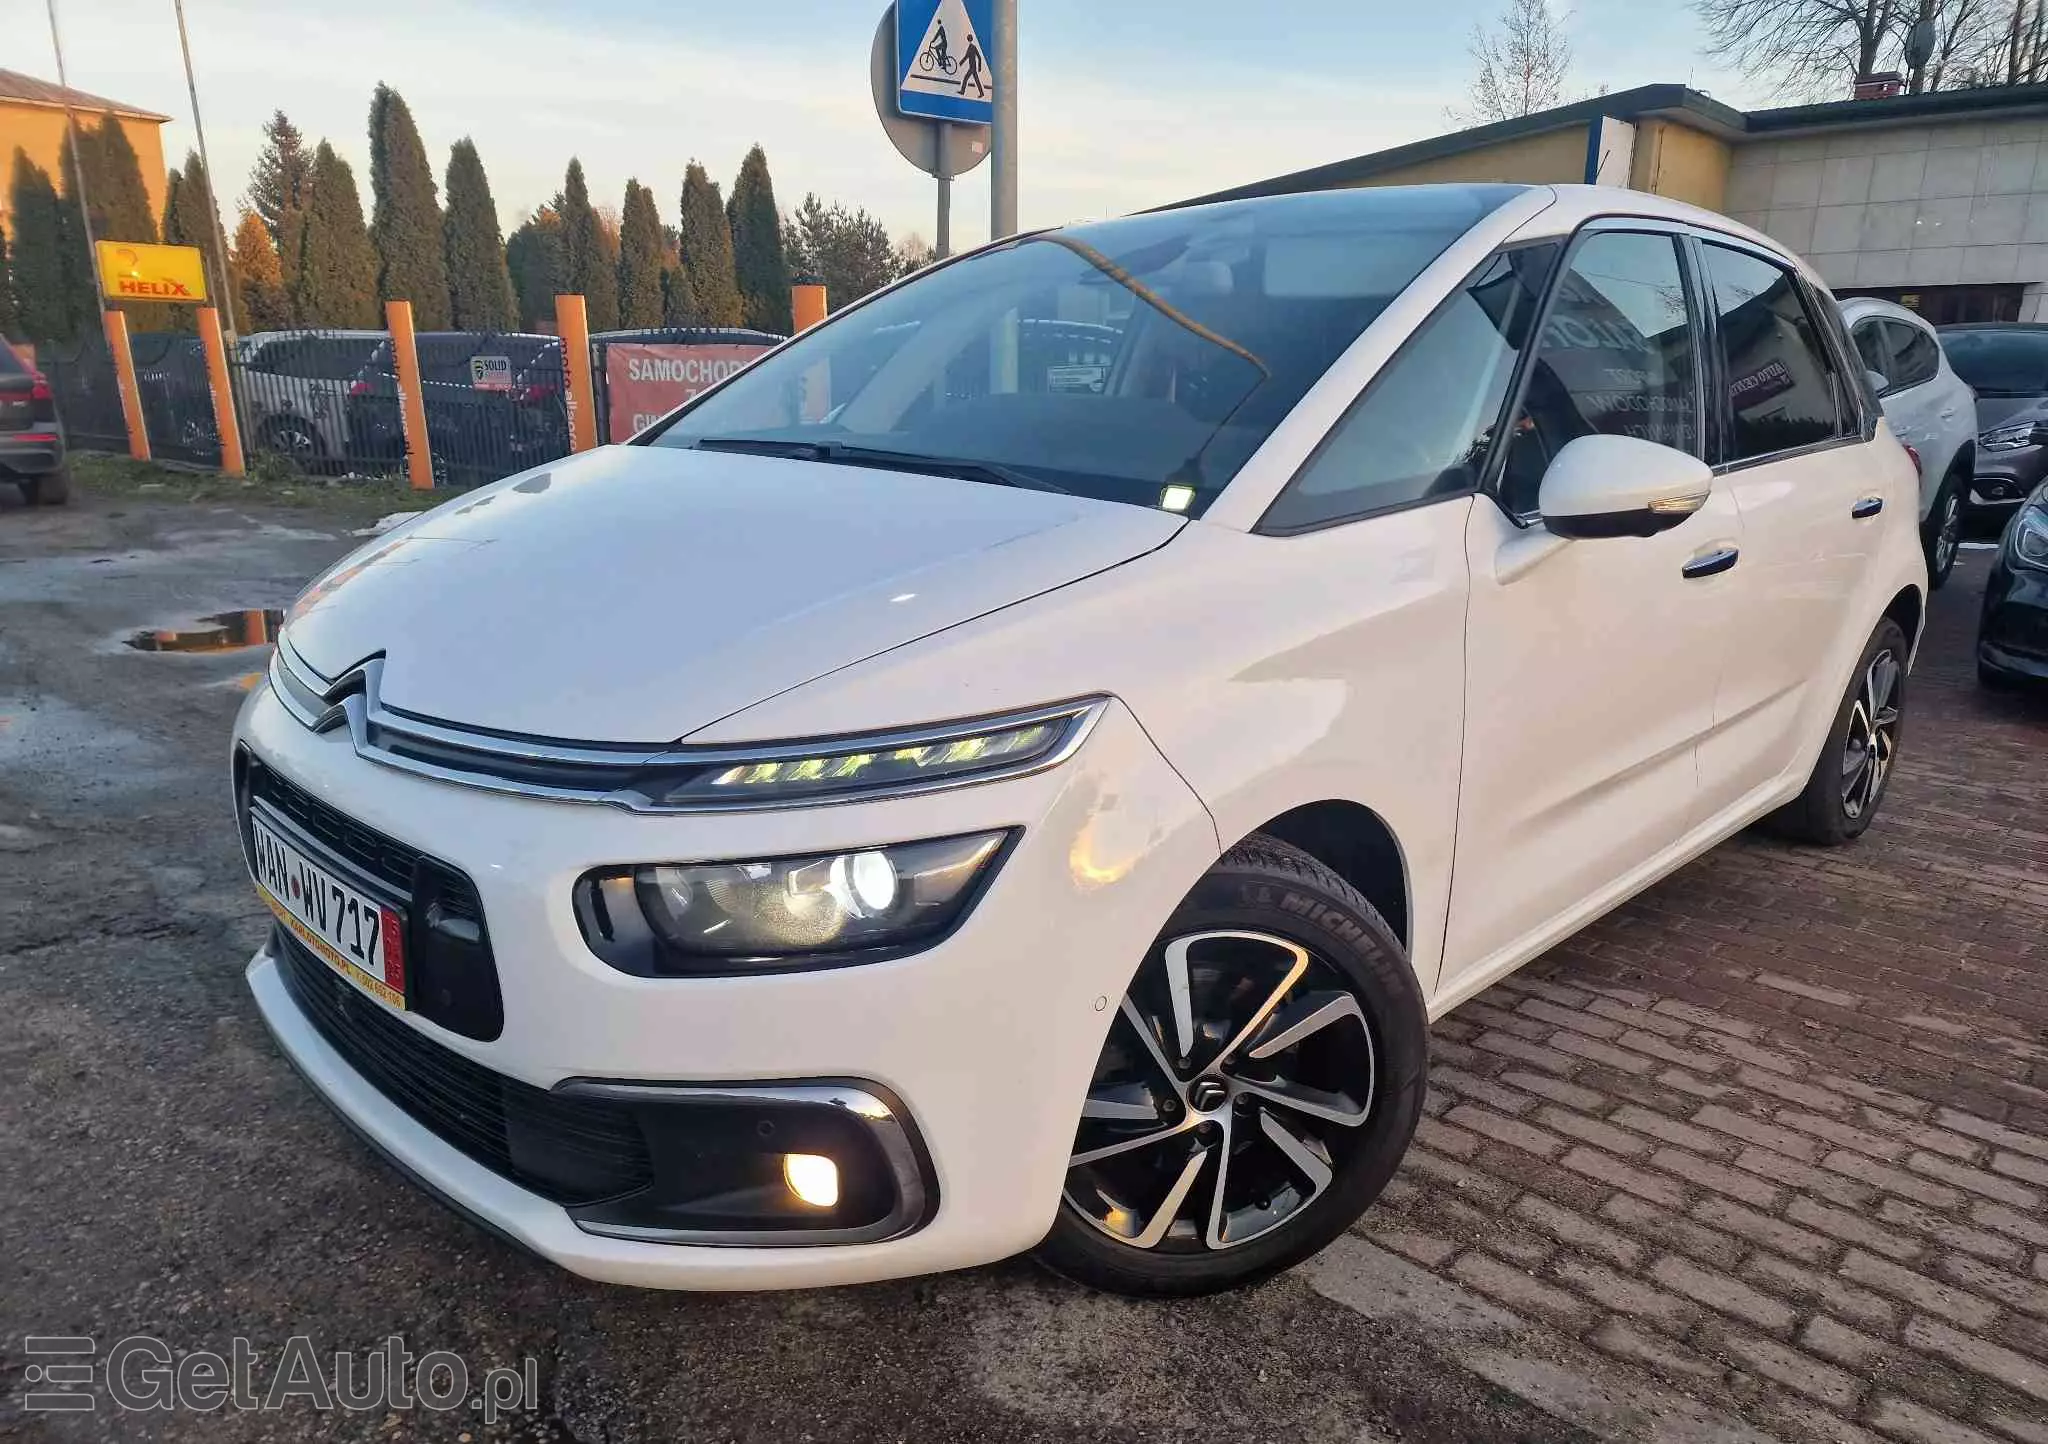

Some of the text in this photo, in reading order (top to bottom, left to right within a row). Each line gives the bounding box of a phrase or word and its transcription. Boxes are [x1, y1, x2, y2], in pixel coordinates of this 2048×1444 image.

[119, 280, 192, 297] HELIX
[485, 359, 507, 371] SOLID
[331, 884, 381, 966] 717
